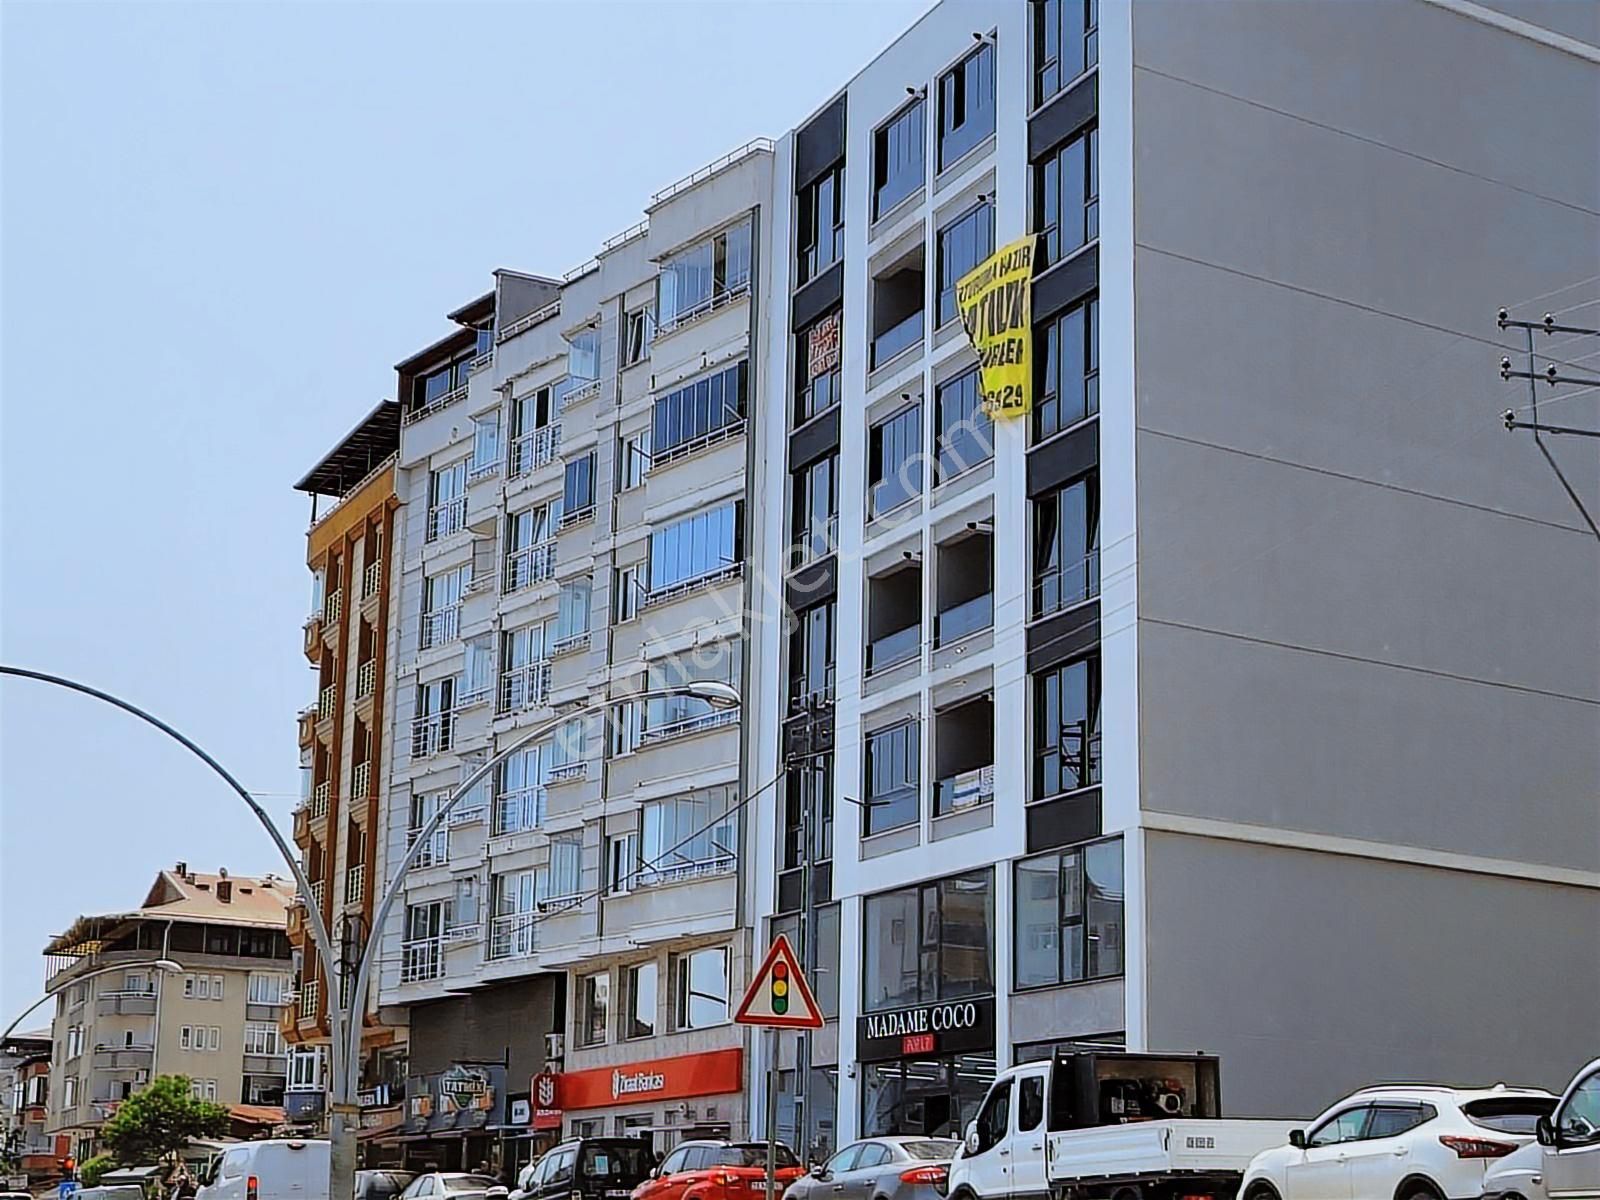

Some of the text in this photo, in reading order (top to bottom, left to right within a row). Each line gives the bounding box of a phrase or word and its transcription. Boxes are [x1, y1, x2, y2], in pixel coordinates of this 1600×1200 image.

[1000, 245, 1031, 278] HAZIR
[868, 1003, 976, 1039] MADAME COCO
